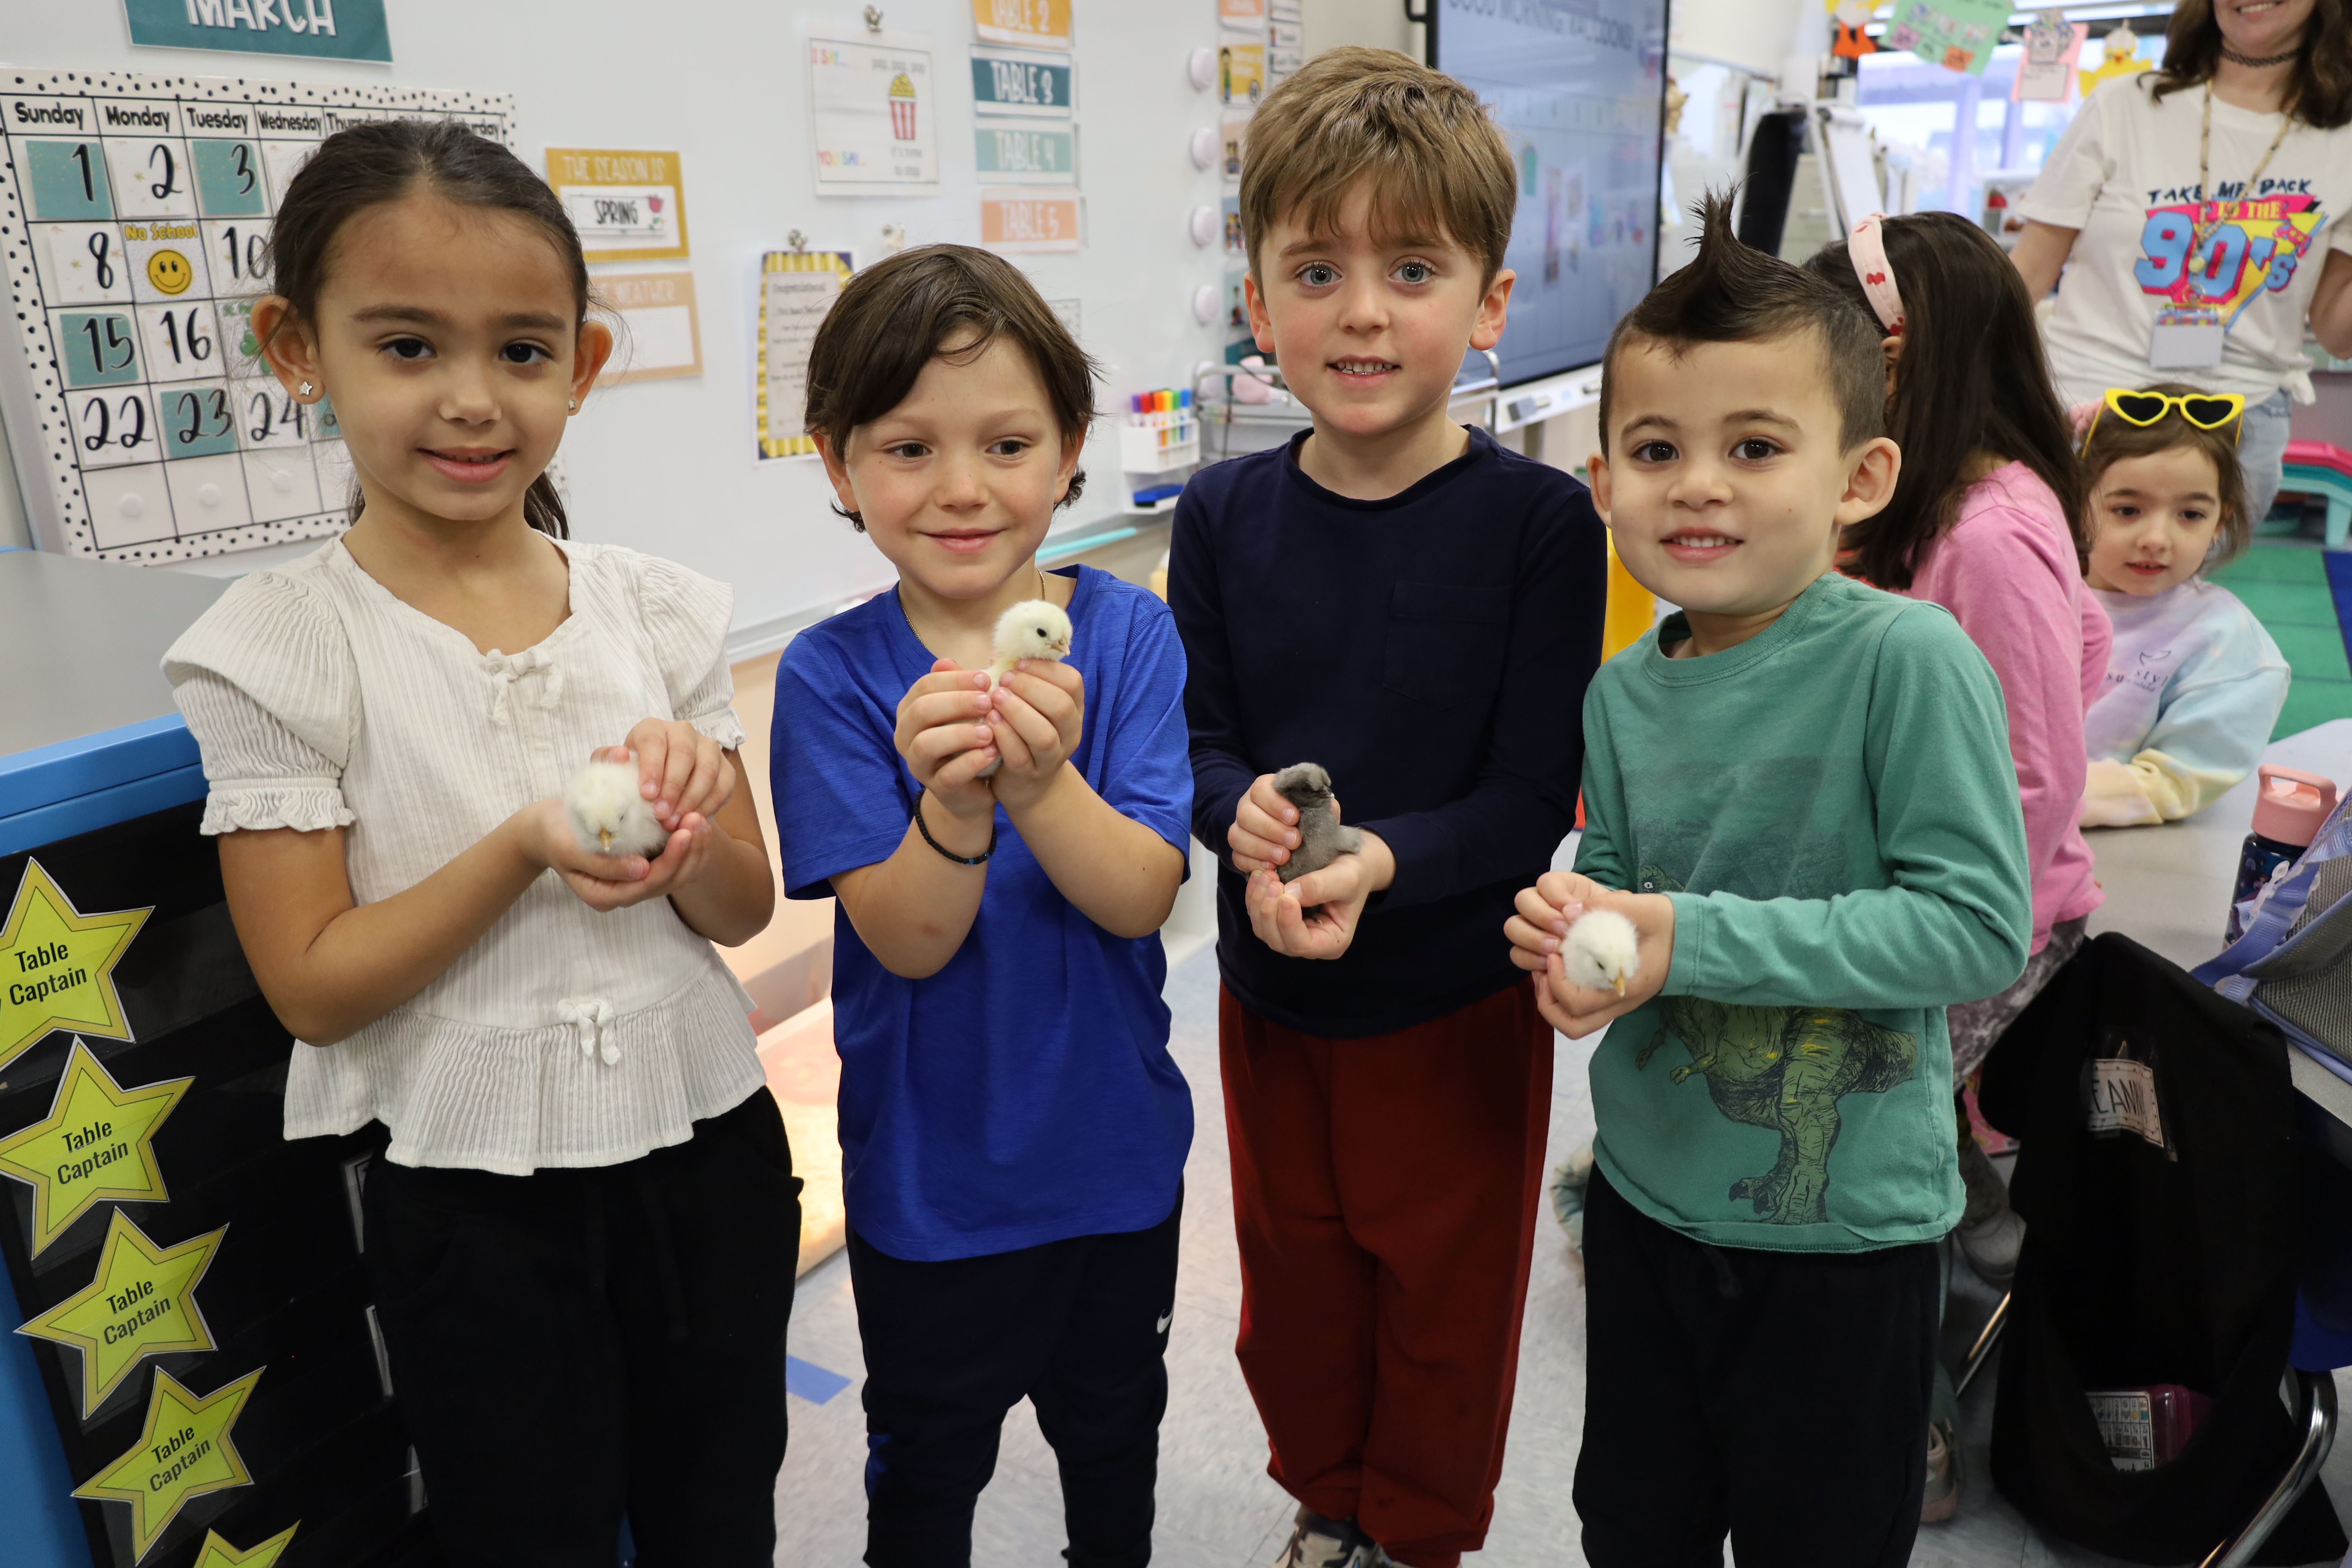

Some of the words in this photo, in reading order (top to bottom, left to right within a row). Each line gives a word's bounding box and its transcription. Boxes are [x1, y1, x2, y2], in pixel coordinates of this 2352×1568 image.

[189, 0, 337, 36] MARCH
[992, 0, 1034, 32] TABLE
[1038, 0, 1050, 32] 2
[991, 60, 1039, 103] TABLE
[1041, 69, 1054, 104] 3
[15, 102, 84, 130] Sunday
[106, 106, 170, 133] Monday
[187, 108, 247, 134] Tuesday
[258, 111, 322, 136] Wednesday
[231, 144, 256, 194] 3
[564, 156, 591, 181] THE
[594, 156, 649, 181] SEASON
[652, 157, 666, 181] IS
[994, 131, 1041, 170] TABLE
[1044, 138, 1054, 170] 4
[72, 144, 94, 201] 1
[150, 144, 183, 199] 2
[2147, 185, 2202, 205] TAKE
[2218, 181, 2246, 198] ME
[2260, 179, 2311, 194] BACK
[2218, 202, 2239, 217] TO
[2246, 201, 2281, 218] THE
[594, 199, 638, 225] SPRING
[1001, 202, 1045, 239] TABLE
[1048, 206, 1060, 237] 5
[124, 224, 147, 240] No
[152, 222, 198, 240] School
[89, 232, 113, 289] 8
[222, 227, 268, 279] 10
[614, 280, 676, 305] WEATHER
[83, 317, 135, 373] 15
[160, 308, 211, 364] 16
[84, 395, 153, 450] 22
[178, 389, 233, 444] 23
[251, 392, 304, 441] 24
[15, 942, 68, 972] Table
[9, 968, 87, 1005] Captain
[62, 1121, 112, 1153] Table
[58, 1143, 129, 1184] Captain
[106, 1281, 153, 1314] Table
[104, 1298, 171, 1344] Captain
[152, 1427, 194, 1463] Table
[150, 1440, 210, 1491] Captain
